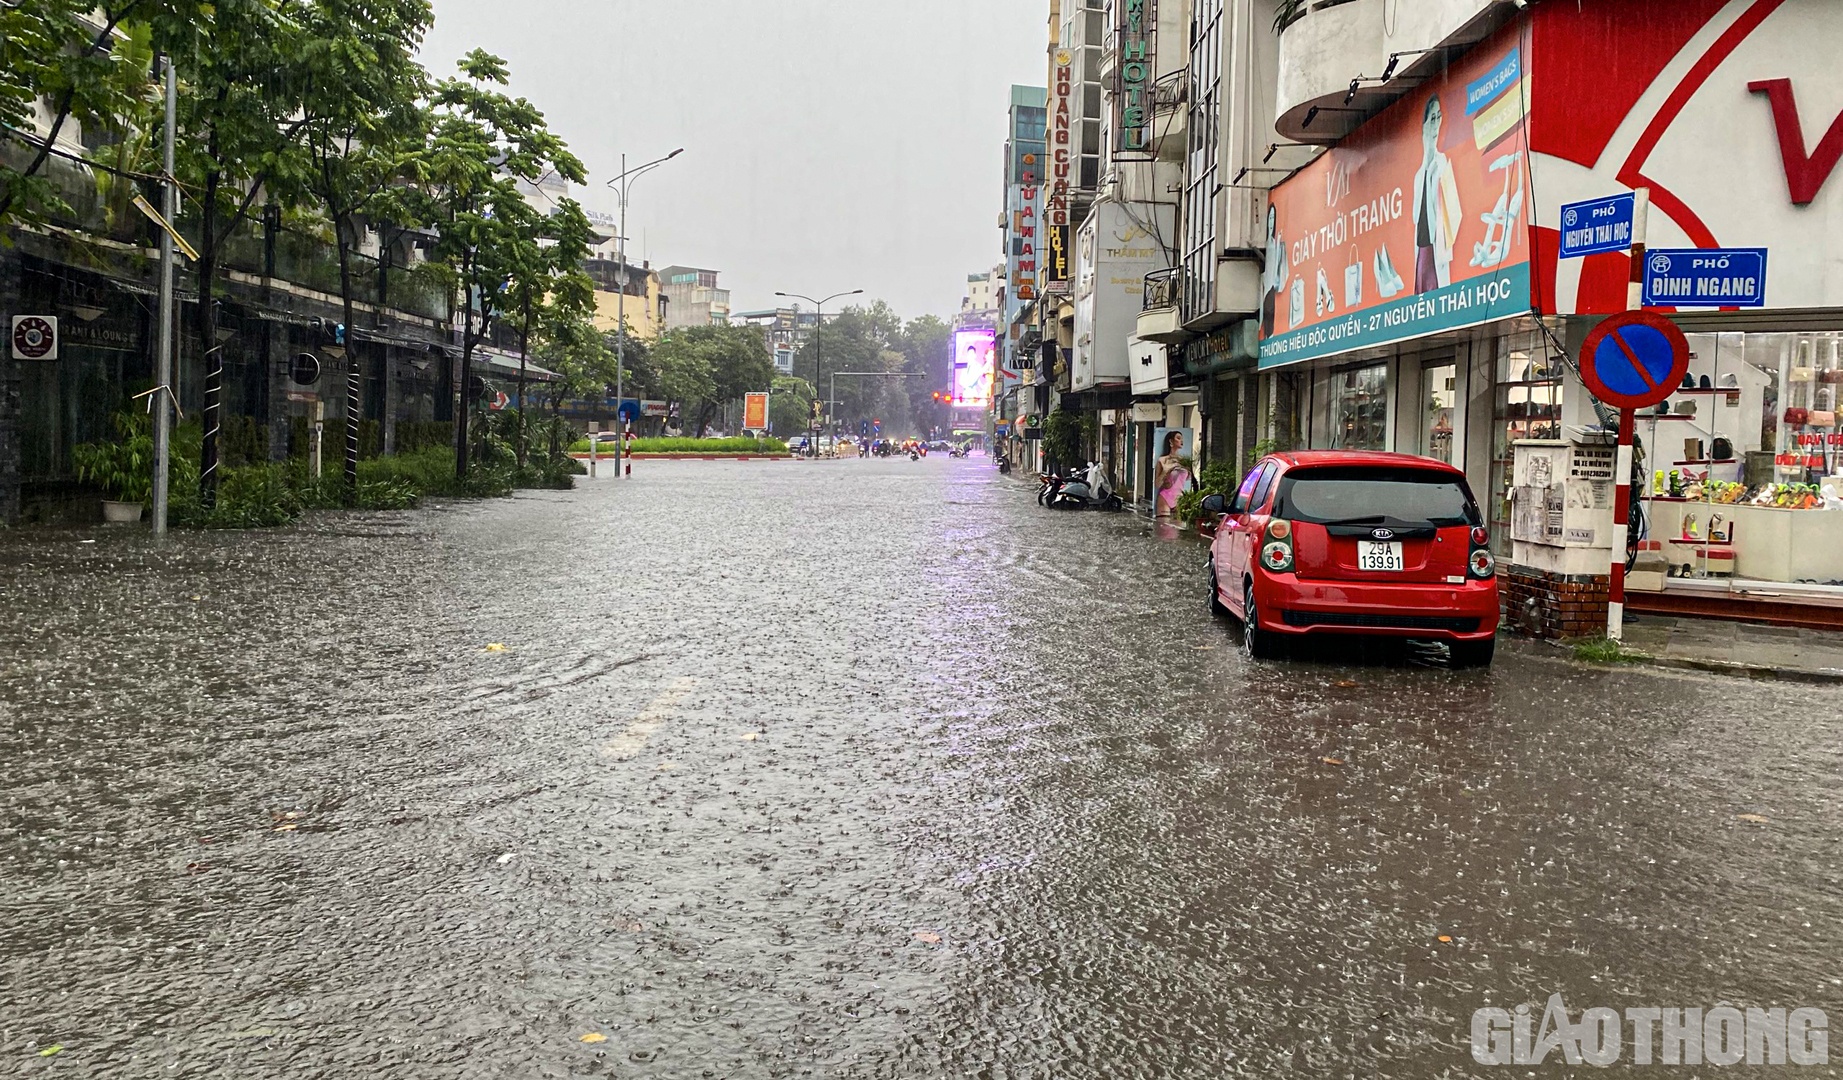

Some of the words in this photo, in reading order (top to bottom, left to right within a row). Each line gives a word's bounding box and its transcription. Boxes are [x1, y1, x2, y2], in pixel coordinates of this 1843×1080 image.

[1123, 40, 1148, 149] HOTEL
[1470, 74, 1499, 104] WOMEN'S
[1500, 58, 1517, 85] BAGS
[1592, 201, 1616, 218] PHỐ
[1292, 229, 1318, 267] GIÀY
[1319, 211, 1348, 253] THỜI
[1350, 187, 1403, 238] TRANG
[1565, 221, 1594, 249] NGUYỄN
[1595, 221, 1613, 244] THÁI
[1613, 220, 1630, 244] HỌC
[1051, 226, 1067, 280] HOTEL
[1692, 254, 1731, 269] PHỐ
[1652, 273, 1692, 296] ĐÌNH
[1696, 276, 1756, 297] NGANG
[1260, 337, 1288, 358] THƯƠNG
[1289, 334, 1308, 355] HIỆU
[1308, 327, 1327, 350] ĐỘC
[1328, 314, 1361, 341] QUYỀN
[1369, 316, 1382, 332] 27
[1383, 293, 1436, 326] NGUYỄN
[1438, 286, 1472, 313] THÁI
[1476, 277, 1512, 306] HỌC
[1361, 555, 1401, 569] 139.91
[1369, 542, 1393, 556] 29A
